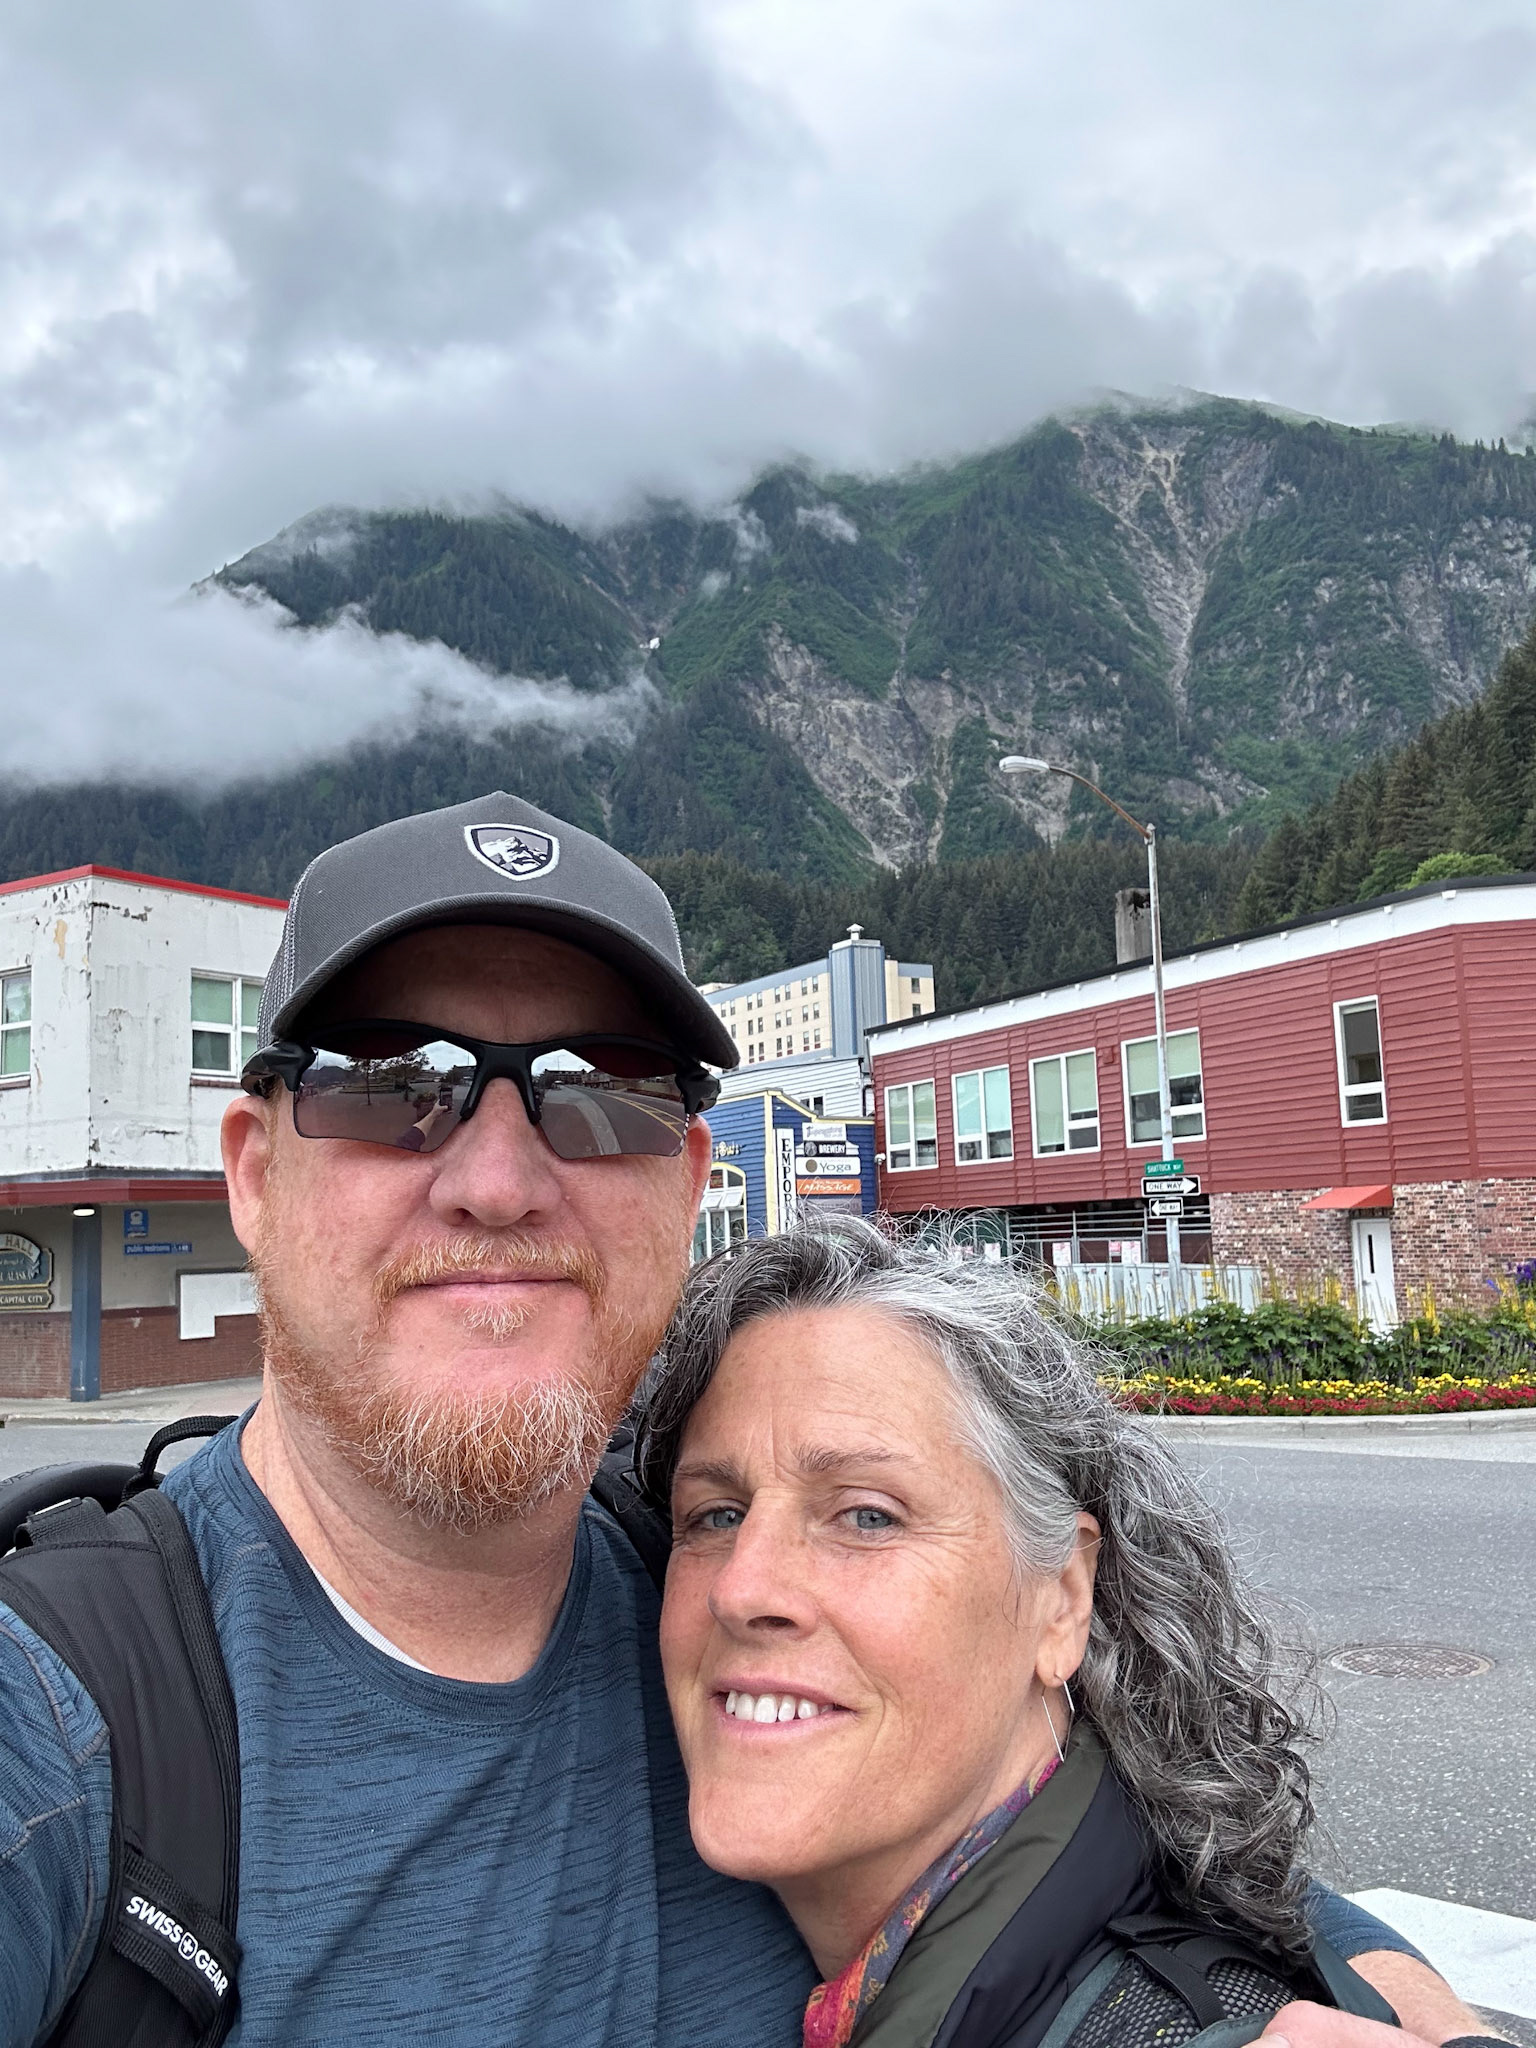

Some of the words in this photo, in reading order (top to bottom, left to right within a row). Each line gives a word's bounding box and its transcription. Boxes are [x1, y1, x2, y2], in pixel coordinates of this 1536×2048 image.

[818, 1144, 846, 1154] BREWERY
[819, 1162, 852, 1173] Yoga
[1167, 1181, 1182, 1189] WAY
[5, 1236, 34, 1257] HALL
[0, 1295, 27, 1304] CAPITAL
[28, 1294, 44, 1304] CITY
[126, 1895, 184, 1943] SWISS
[194, 1948, 229, 1997] GEAR
